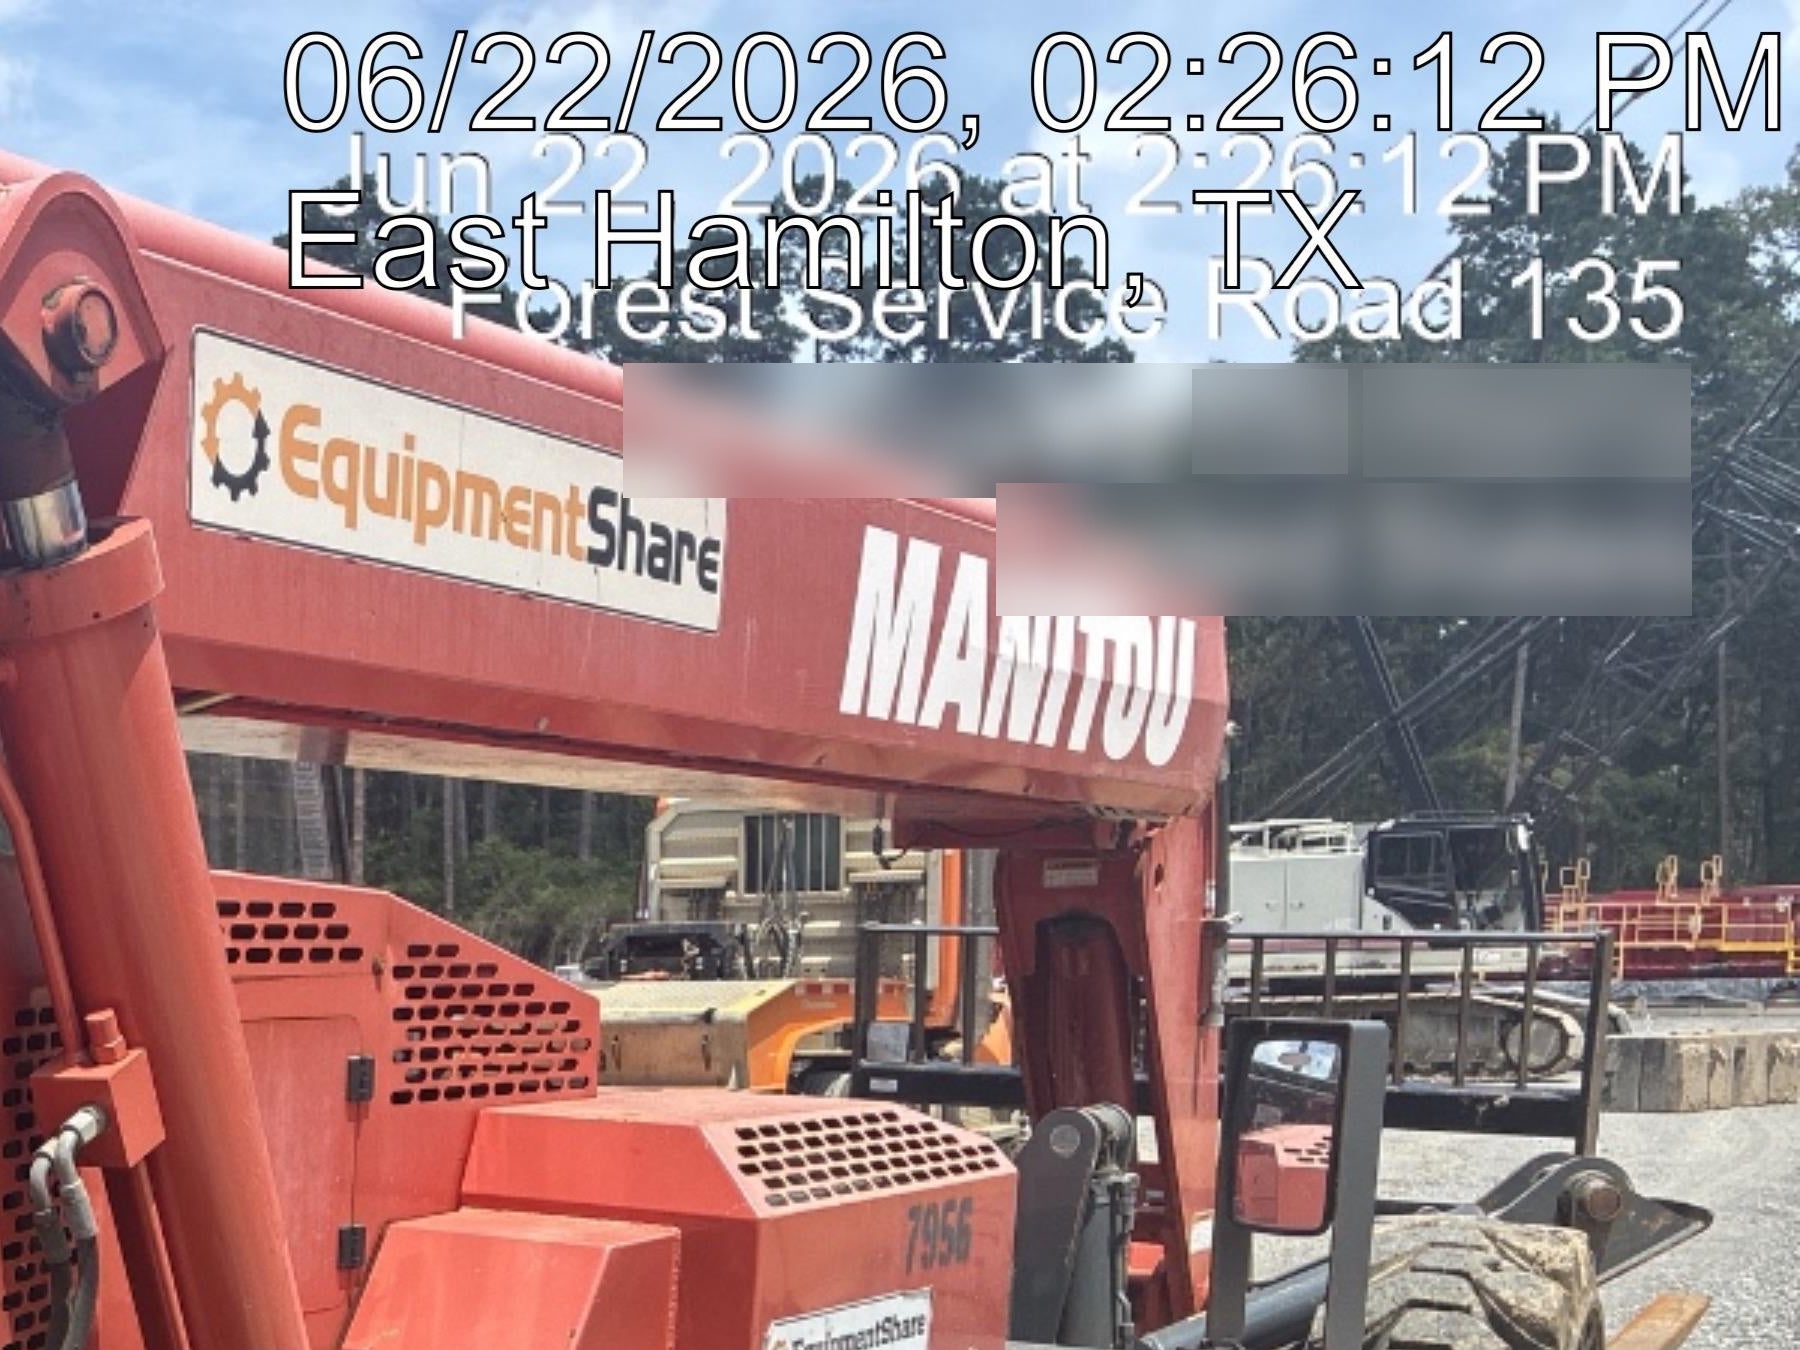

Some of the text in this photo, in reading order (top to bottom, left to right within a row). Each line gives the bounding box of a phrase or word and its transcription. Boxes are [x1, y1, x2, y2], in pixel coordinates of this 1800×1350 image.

[279, 403, 721, 594] EquipmentShare
[840, 524, 1197, 767] MANITOU
[905, 1196, 974, 1276] 7956
